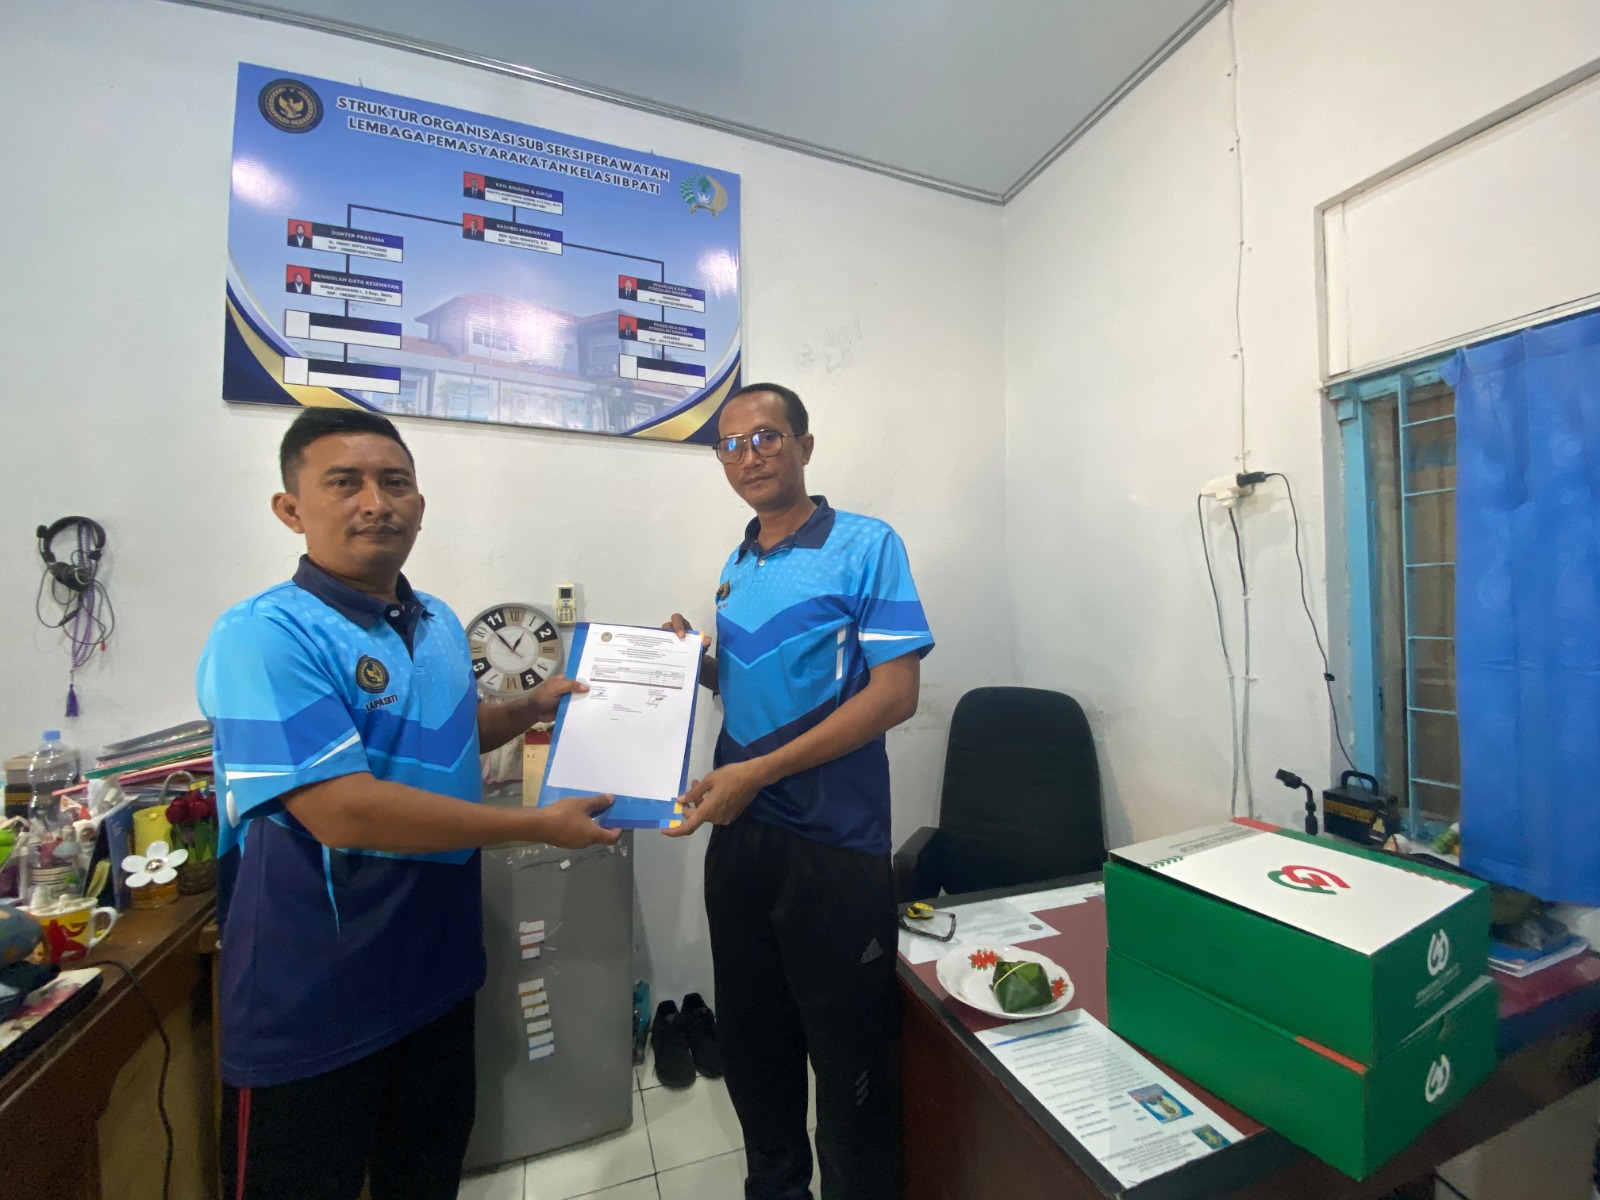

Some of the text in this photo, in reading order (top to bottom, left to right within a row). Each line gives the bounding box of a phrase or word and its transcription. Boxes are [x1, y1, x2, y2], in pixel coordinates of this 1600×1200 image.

[337, 97, 670, 181] STRUKTUR ORGANISASI SUB SEKSI PERAWATAN
[349, 117, 424, 143] LEMBAGA
[427, 134, 569, 175] PEMASYARAKATAN
[569, 166, 611, 184] KELAS
[622, 177, 630, 188] B
[631, 179, 660, 195] PATI
[331, 230, 385, 243] DOKTER PRATAMA
[519, 227, 551, 238] PERAWATAN
[313, 273, 347, 283] PENGOLAH
[365, 280, 399, 290] KESEHATAN
[488, 613, 503, 626] 11
[510, 610, 519, 622] XII
[540, 628, 552, 638] 2
[525, 674, 535, 685] 5
